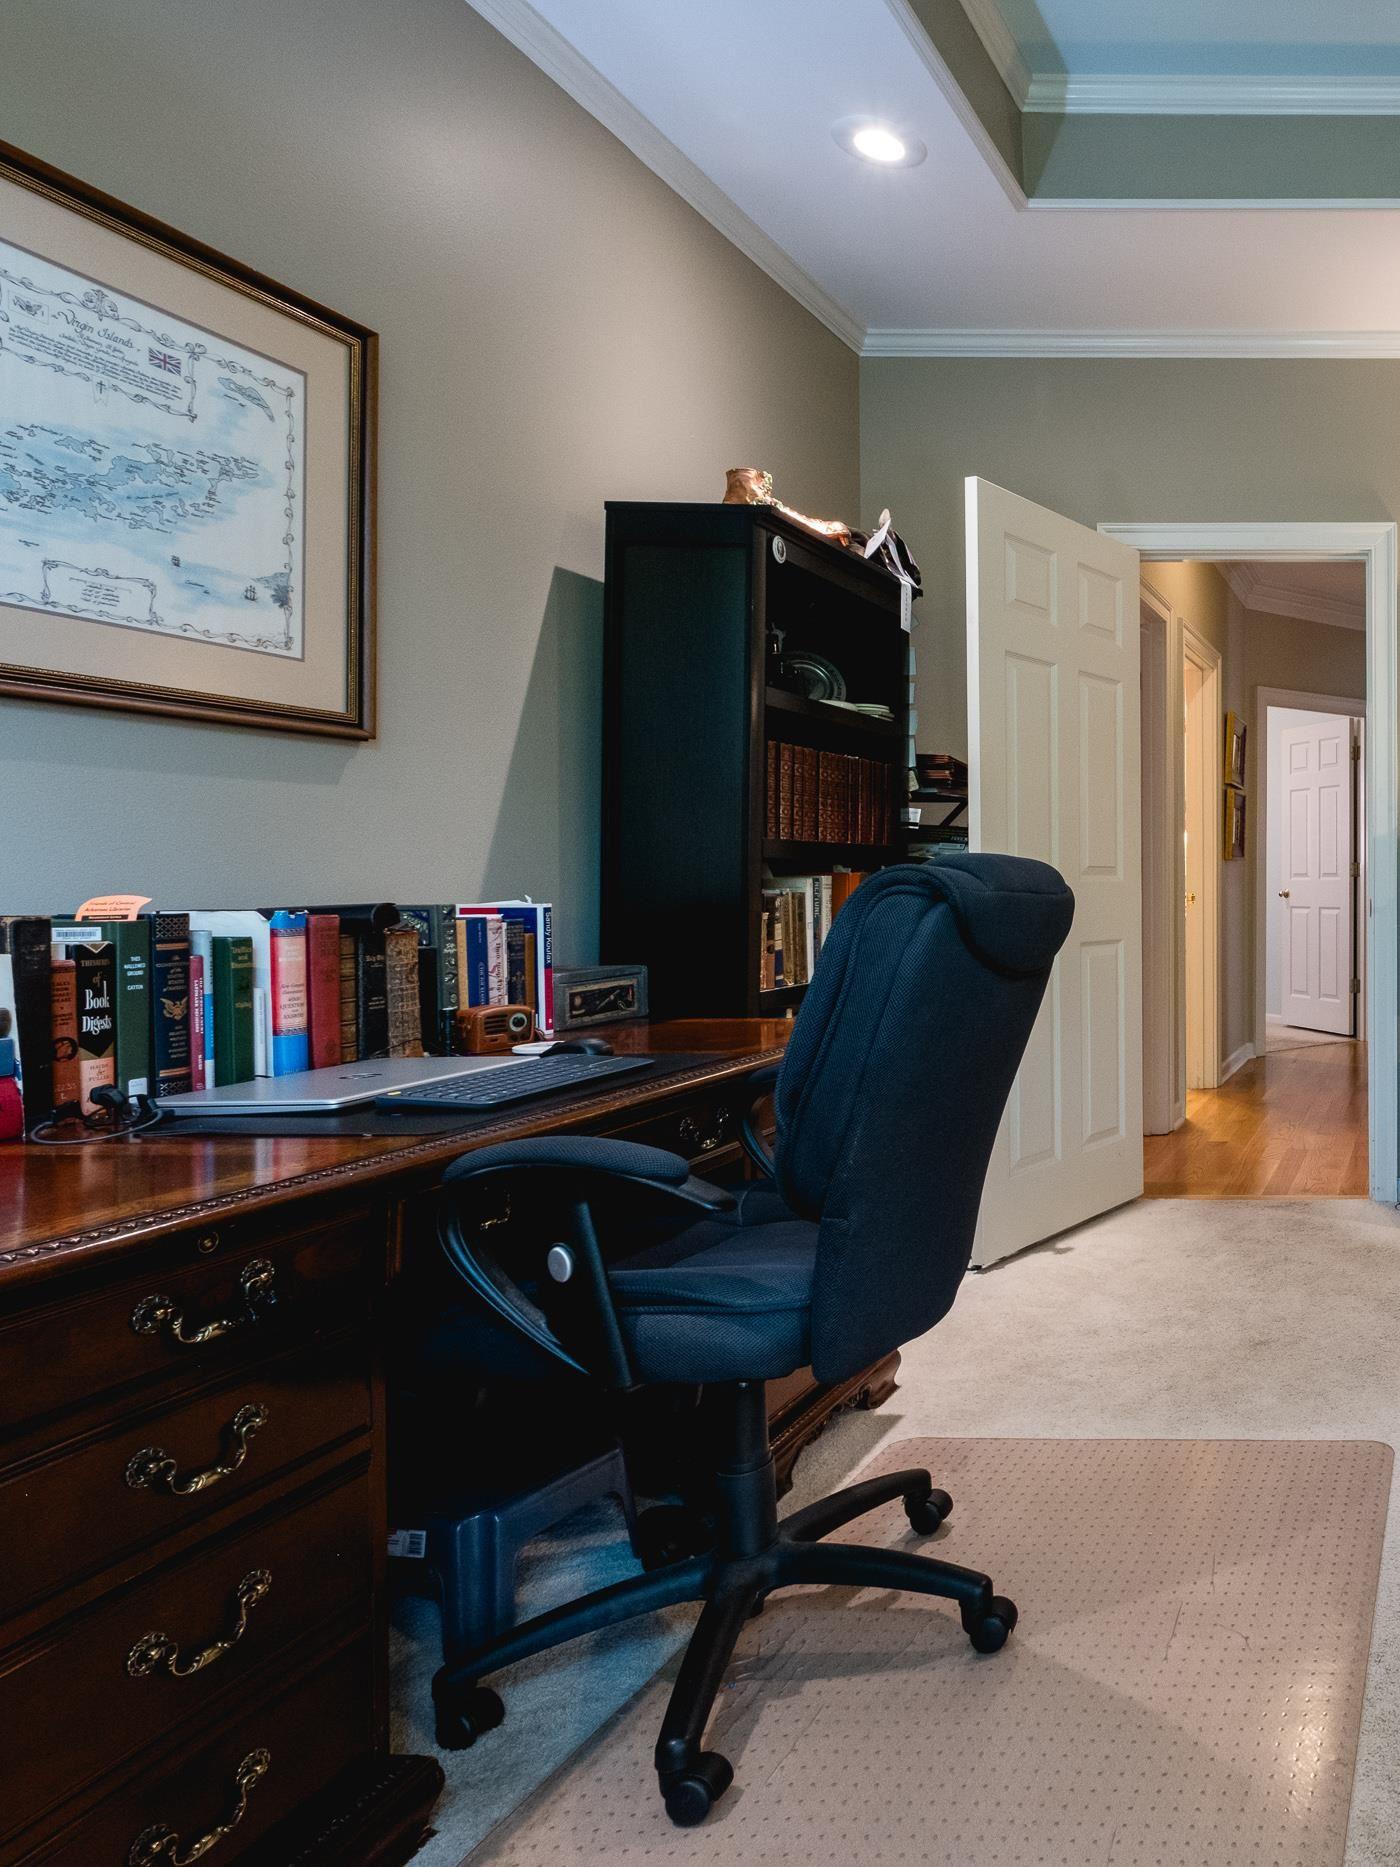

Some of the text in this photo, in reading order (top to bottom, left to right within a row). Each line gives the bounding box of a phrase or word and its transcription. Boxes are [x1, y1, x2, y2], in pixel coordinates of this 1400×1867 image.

[57, 308, 134, 348] Virgin Islands
[93, 971, 102, 987] of
[84, 980, 110, 1010] Book
[81, 1015, 112, 1035] Digests
